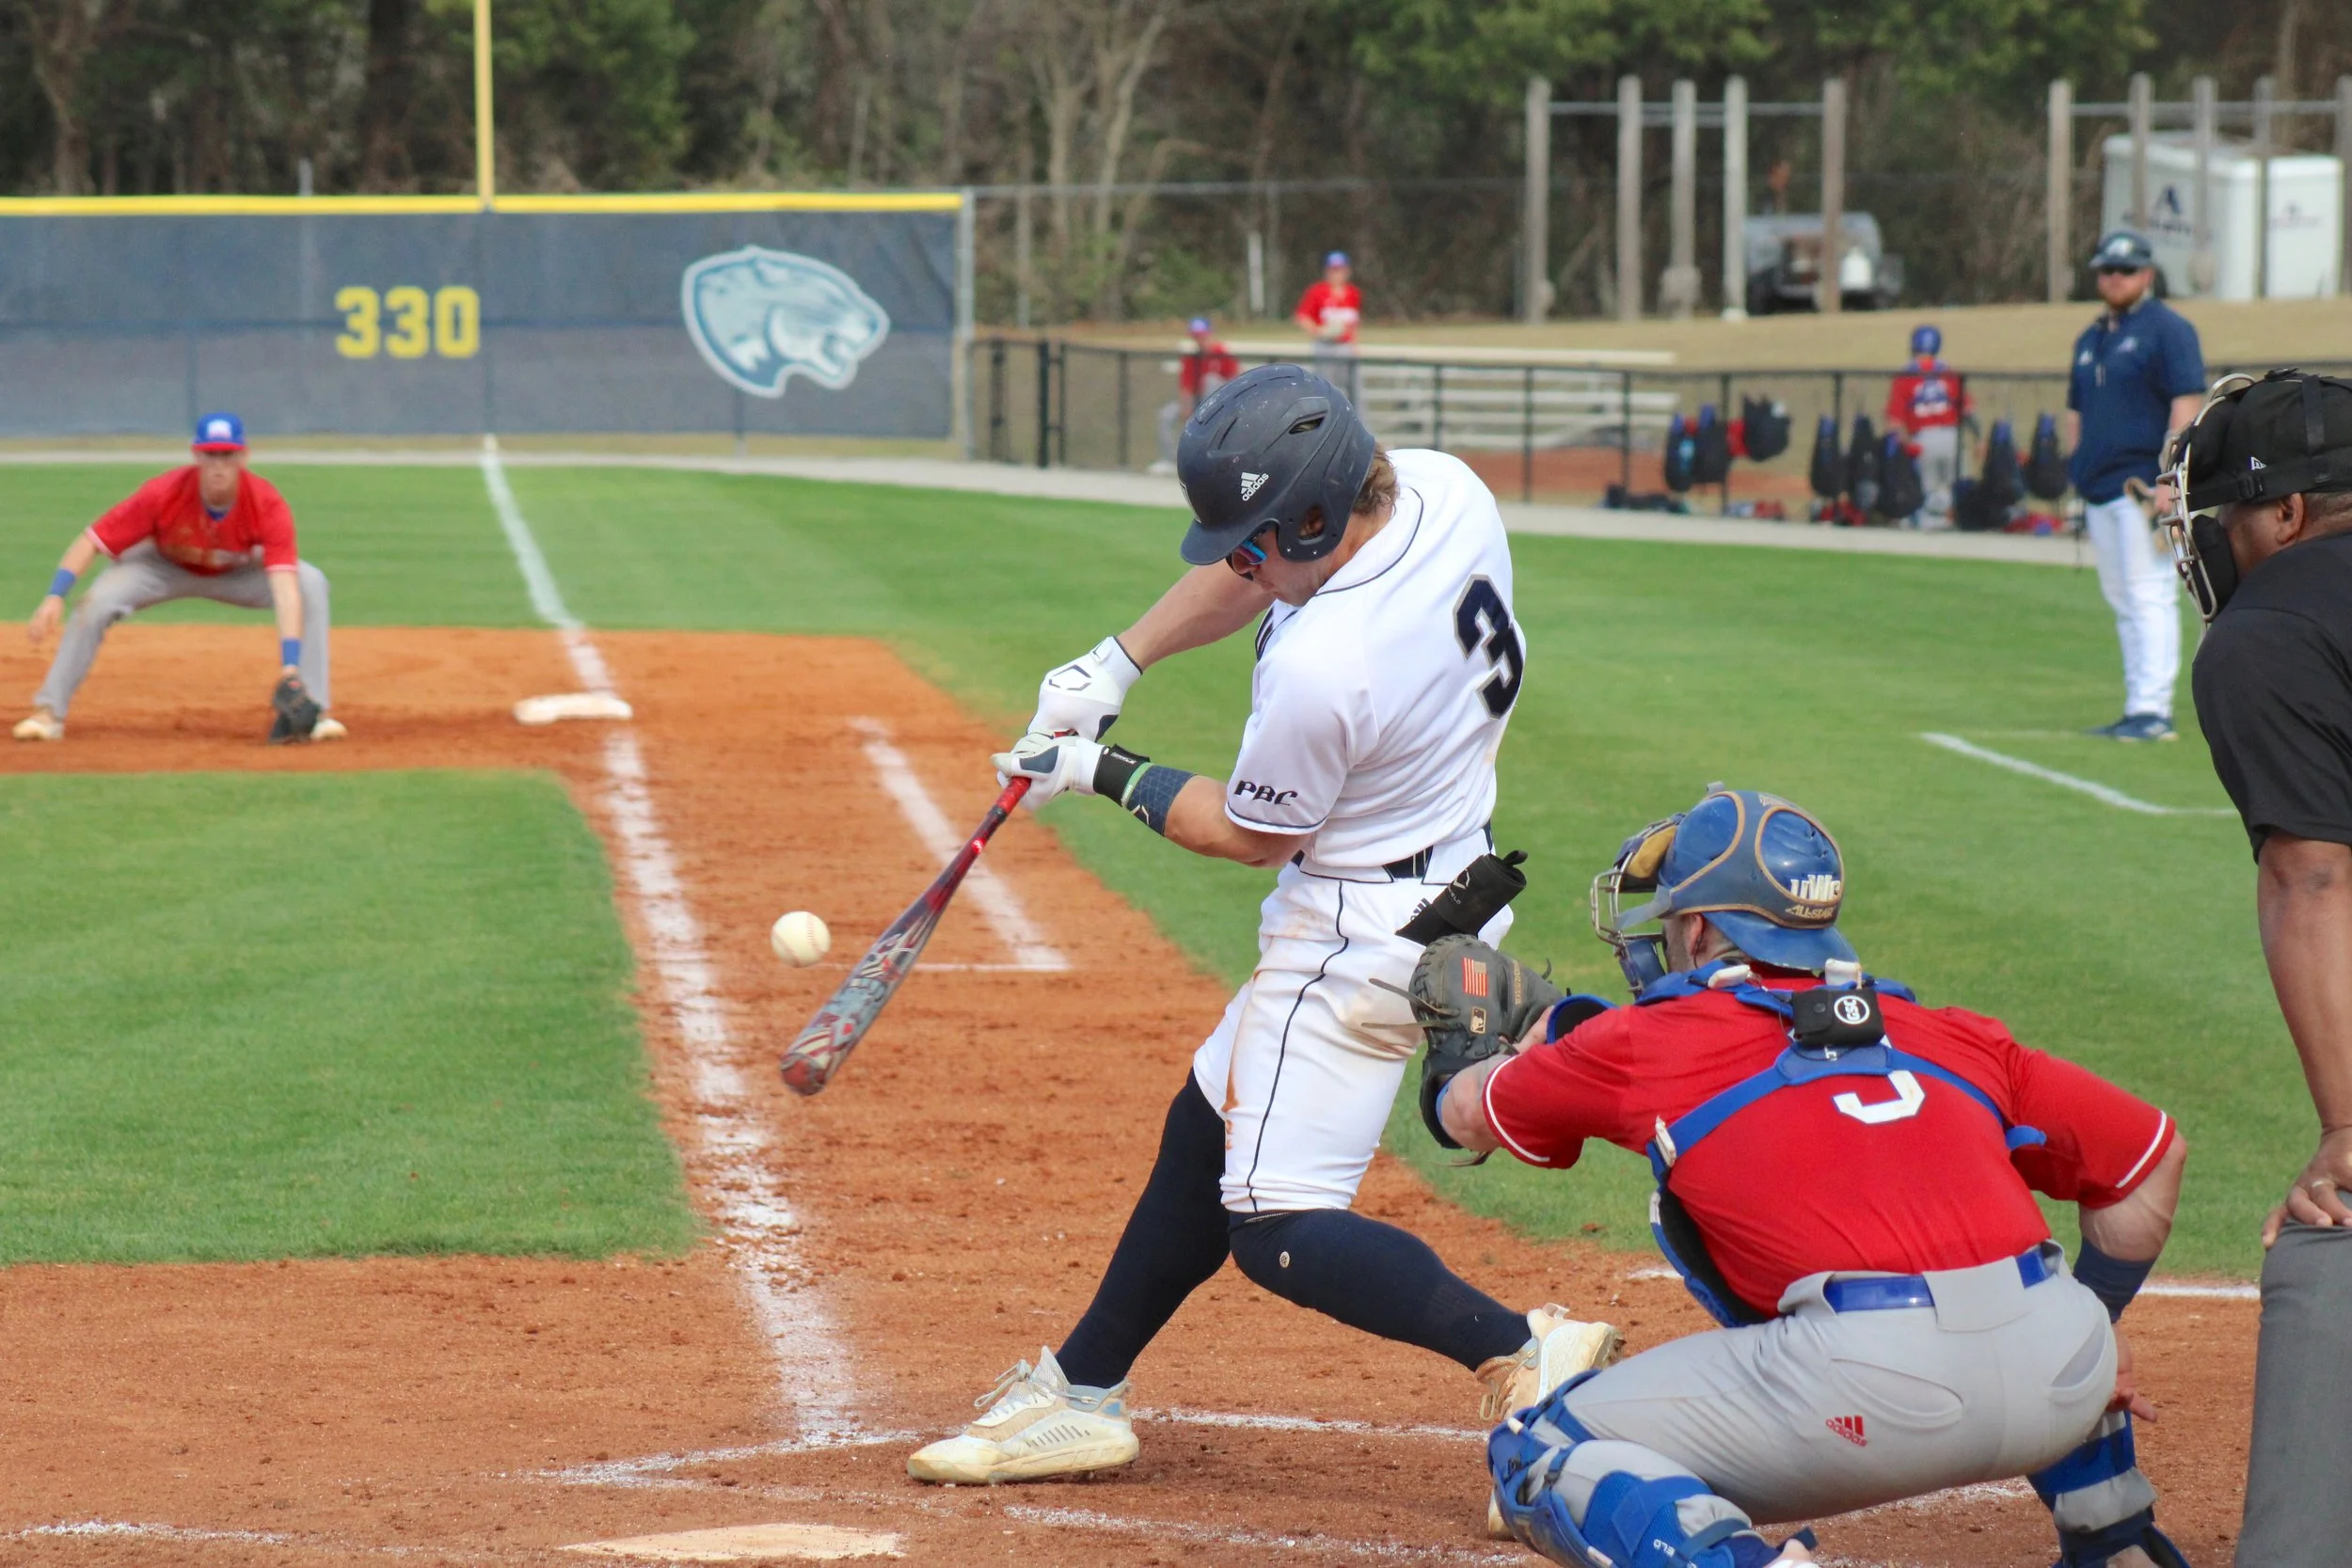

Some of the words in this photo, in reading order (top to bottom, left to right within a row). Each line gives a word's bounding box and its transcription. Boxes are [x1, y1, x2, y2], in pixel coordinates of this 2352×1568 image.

[334, 285, 481, 358] 330
[1242, 473, 1269, 501] adidas
[1452, 573, 1524, 720] 3
[1233, 780, 1298, 806] PBC
